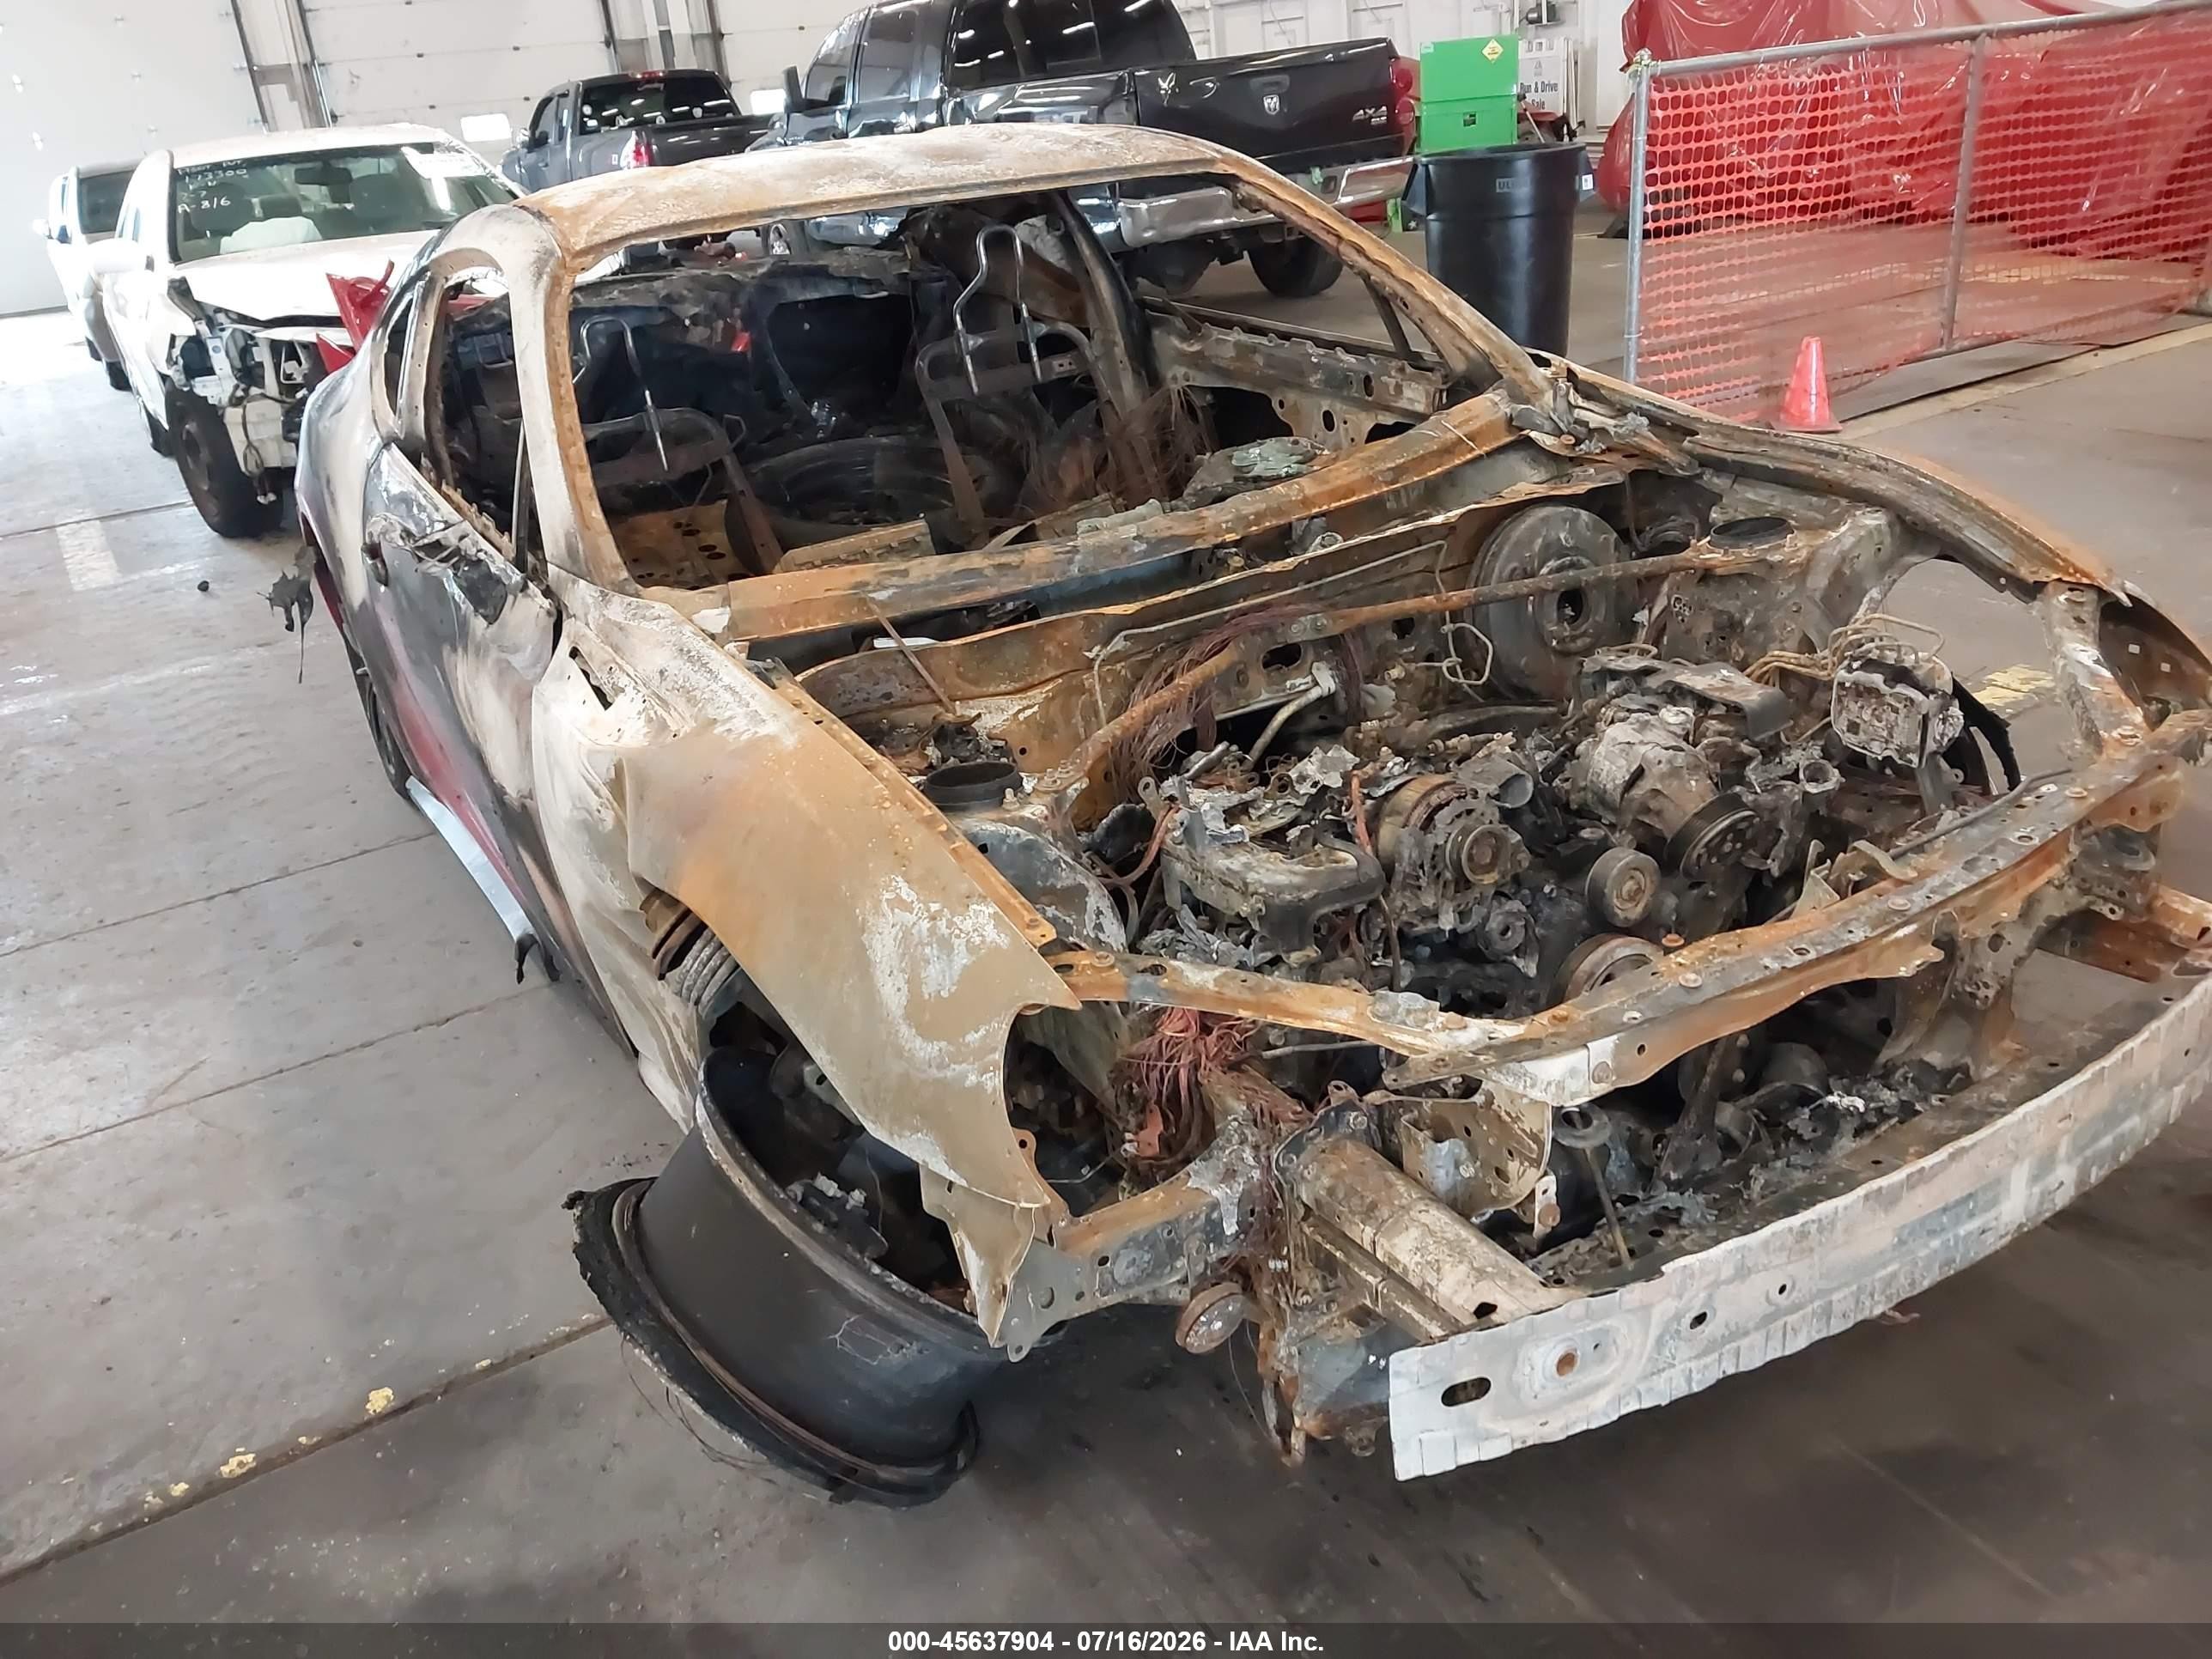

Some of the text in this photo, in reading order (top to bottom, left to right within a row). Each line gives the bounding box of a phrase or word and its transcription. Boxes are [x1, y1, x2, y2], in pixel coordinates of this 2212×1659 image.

[1520, 80, 1559, 94] Run & Drive
